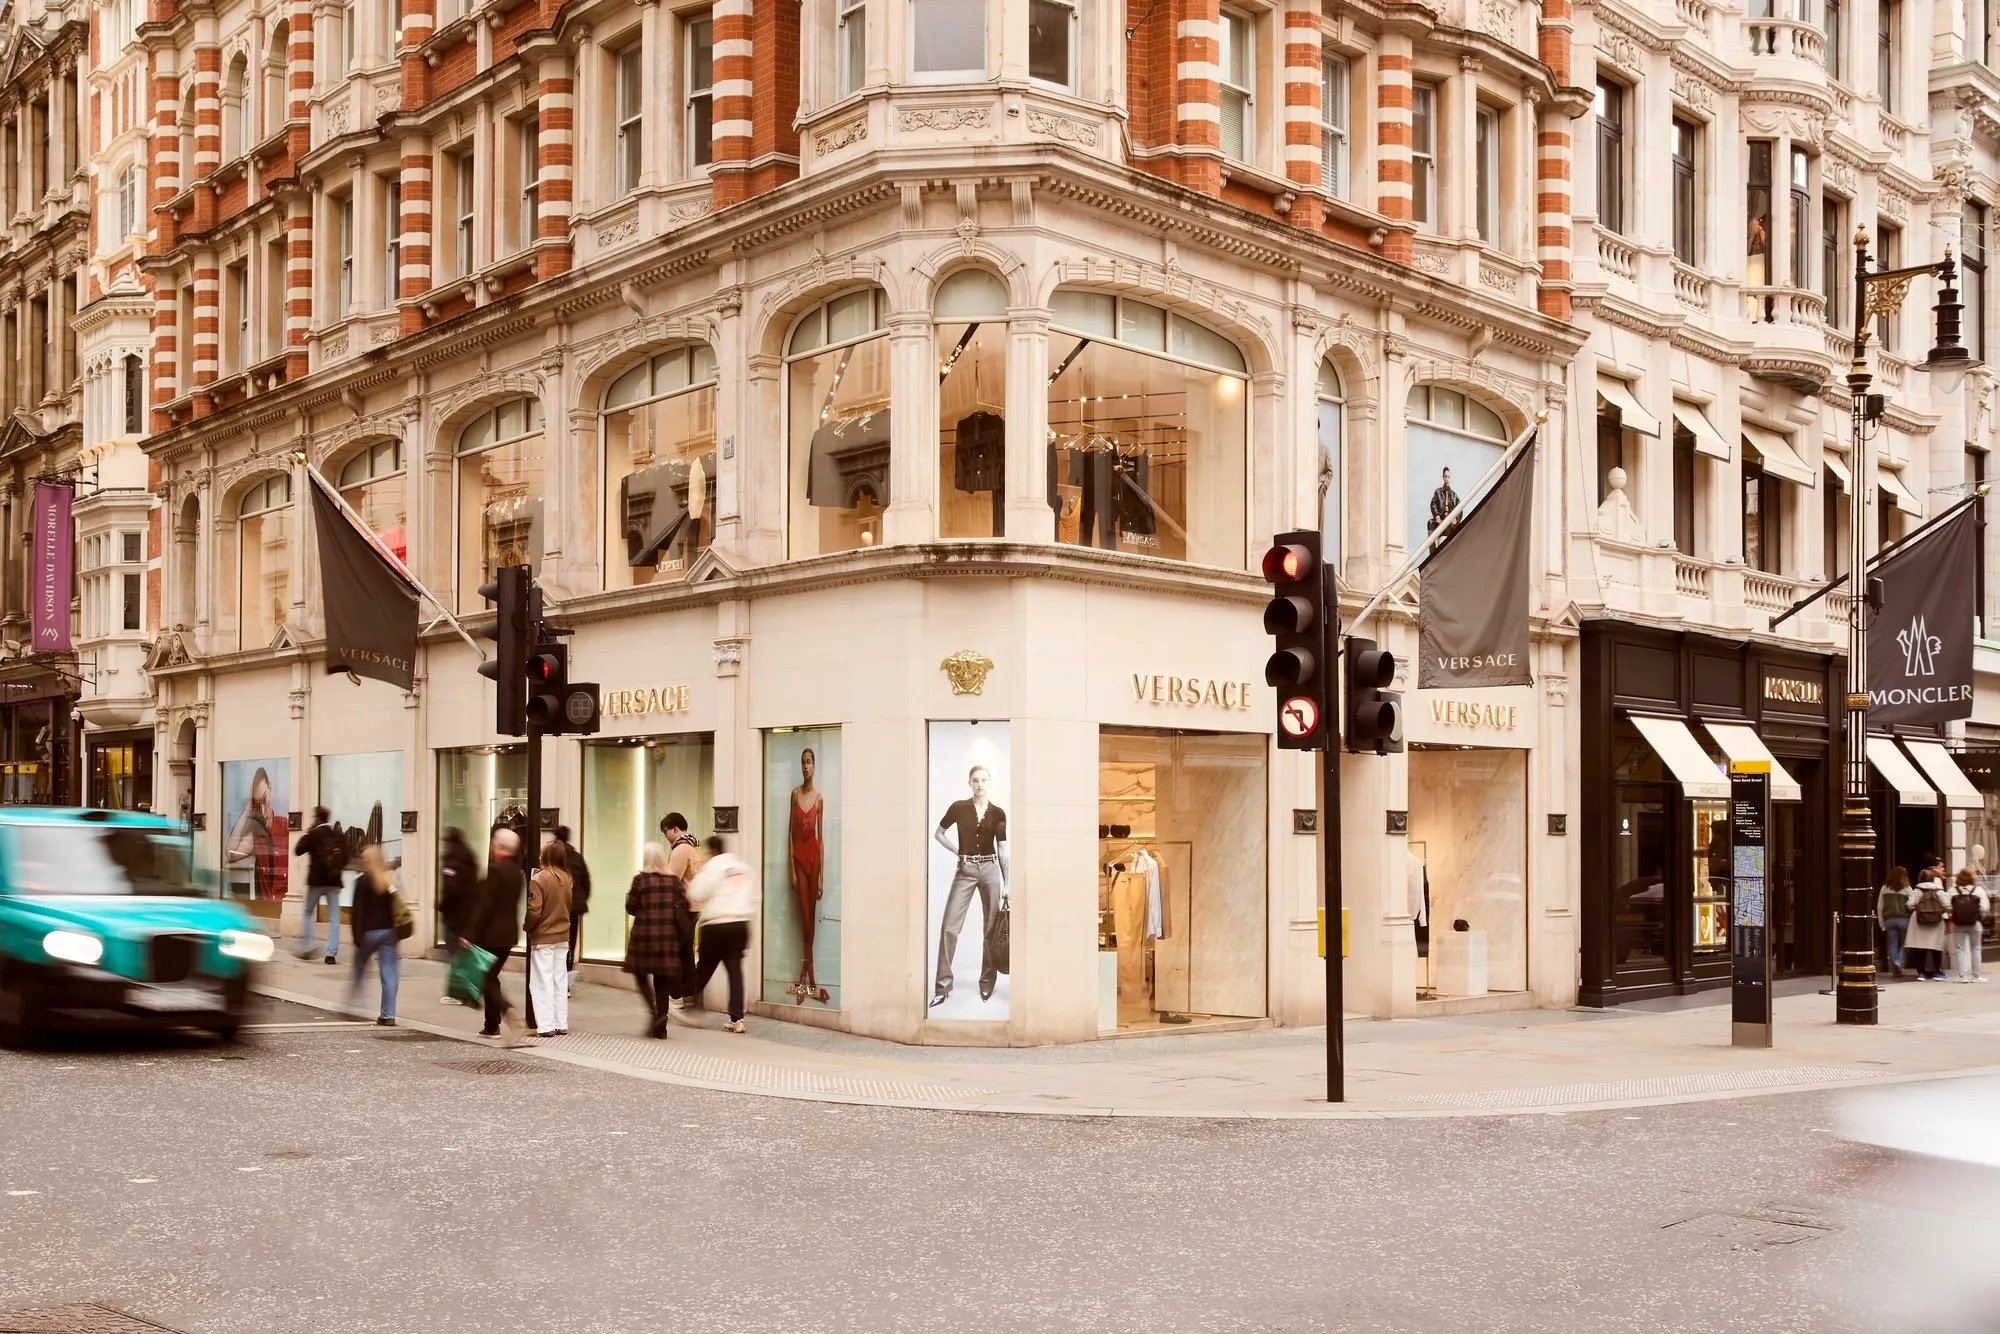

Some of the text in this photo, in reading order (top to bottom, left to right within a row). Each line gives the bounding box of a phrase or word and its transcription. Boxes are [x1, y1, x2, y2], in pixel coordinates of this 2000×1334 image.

[45, 504, 57, 620] MORELLE DAVIDSON
[340, 647, 409, 672] VERSACE
[1438, 653, 1517, 670] VERSACE
[1131, 673, 1252, 708] VERSACE
[1868, 684, 1974, 706] MONCLER
[1430, 699, 1517, 729] VERSACE
